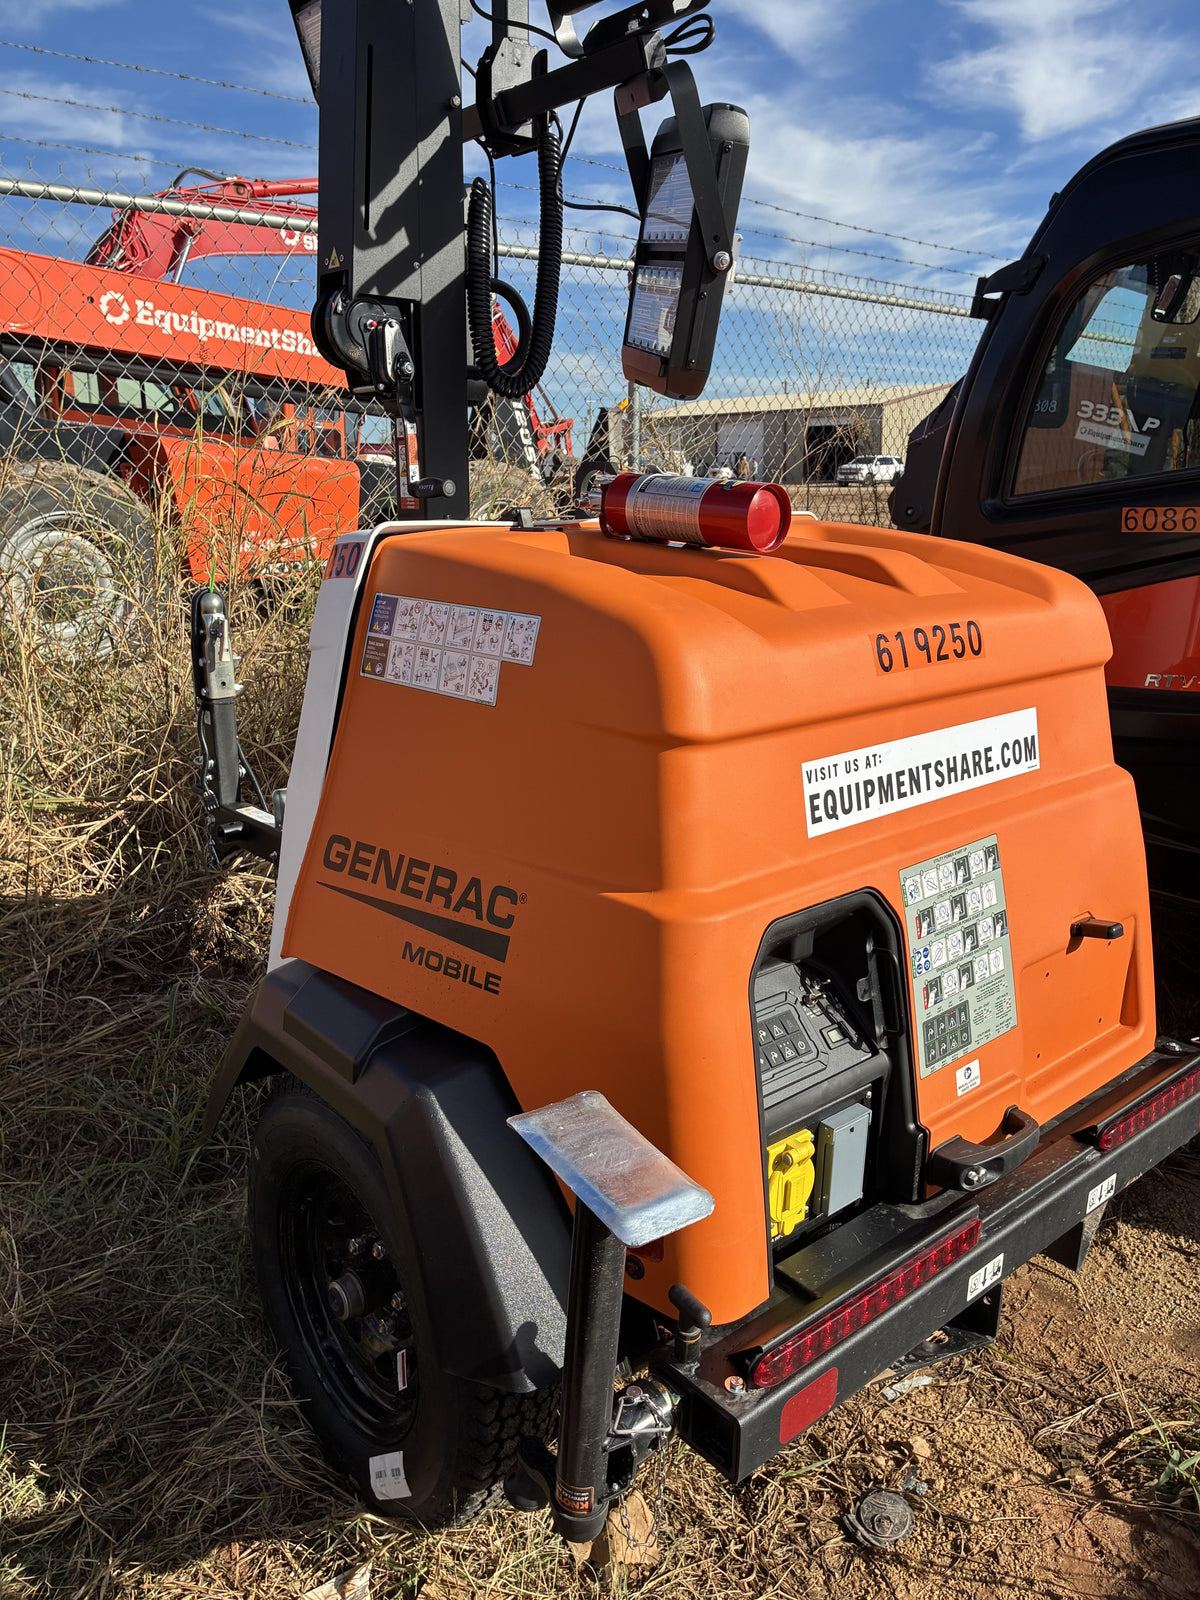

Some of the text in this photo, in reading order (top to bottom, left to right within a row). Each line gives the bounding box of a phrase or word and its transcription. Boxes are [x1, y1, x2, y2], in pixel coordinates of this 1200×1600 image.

[875, 620, 983, 673] 619250
[805, 752, 883, 785] VISIT US AT:
[809, 734, 1037, 821] EQUIPMENTSHARE.COM
[401, 940, 502, 996] MOBILE
